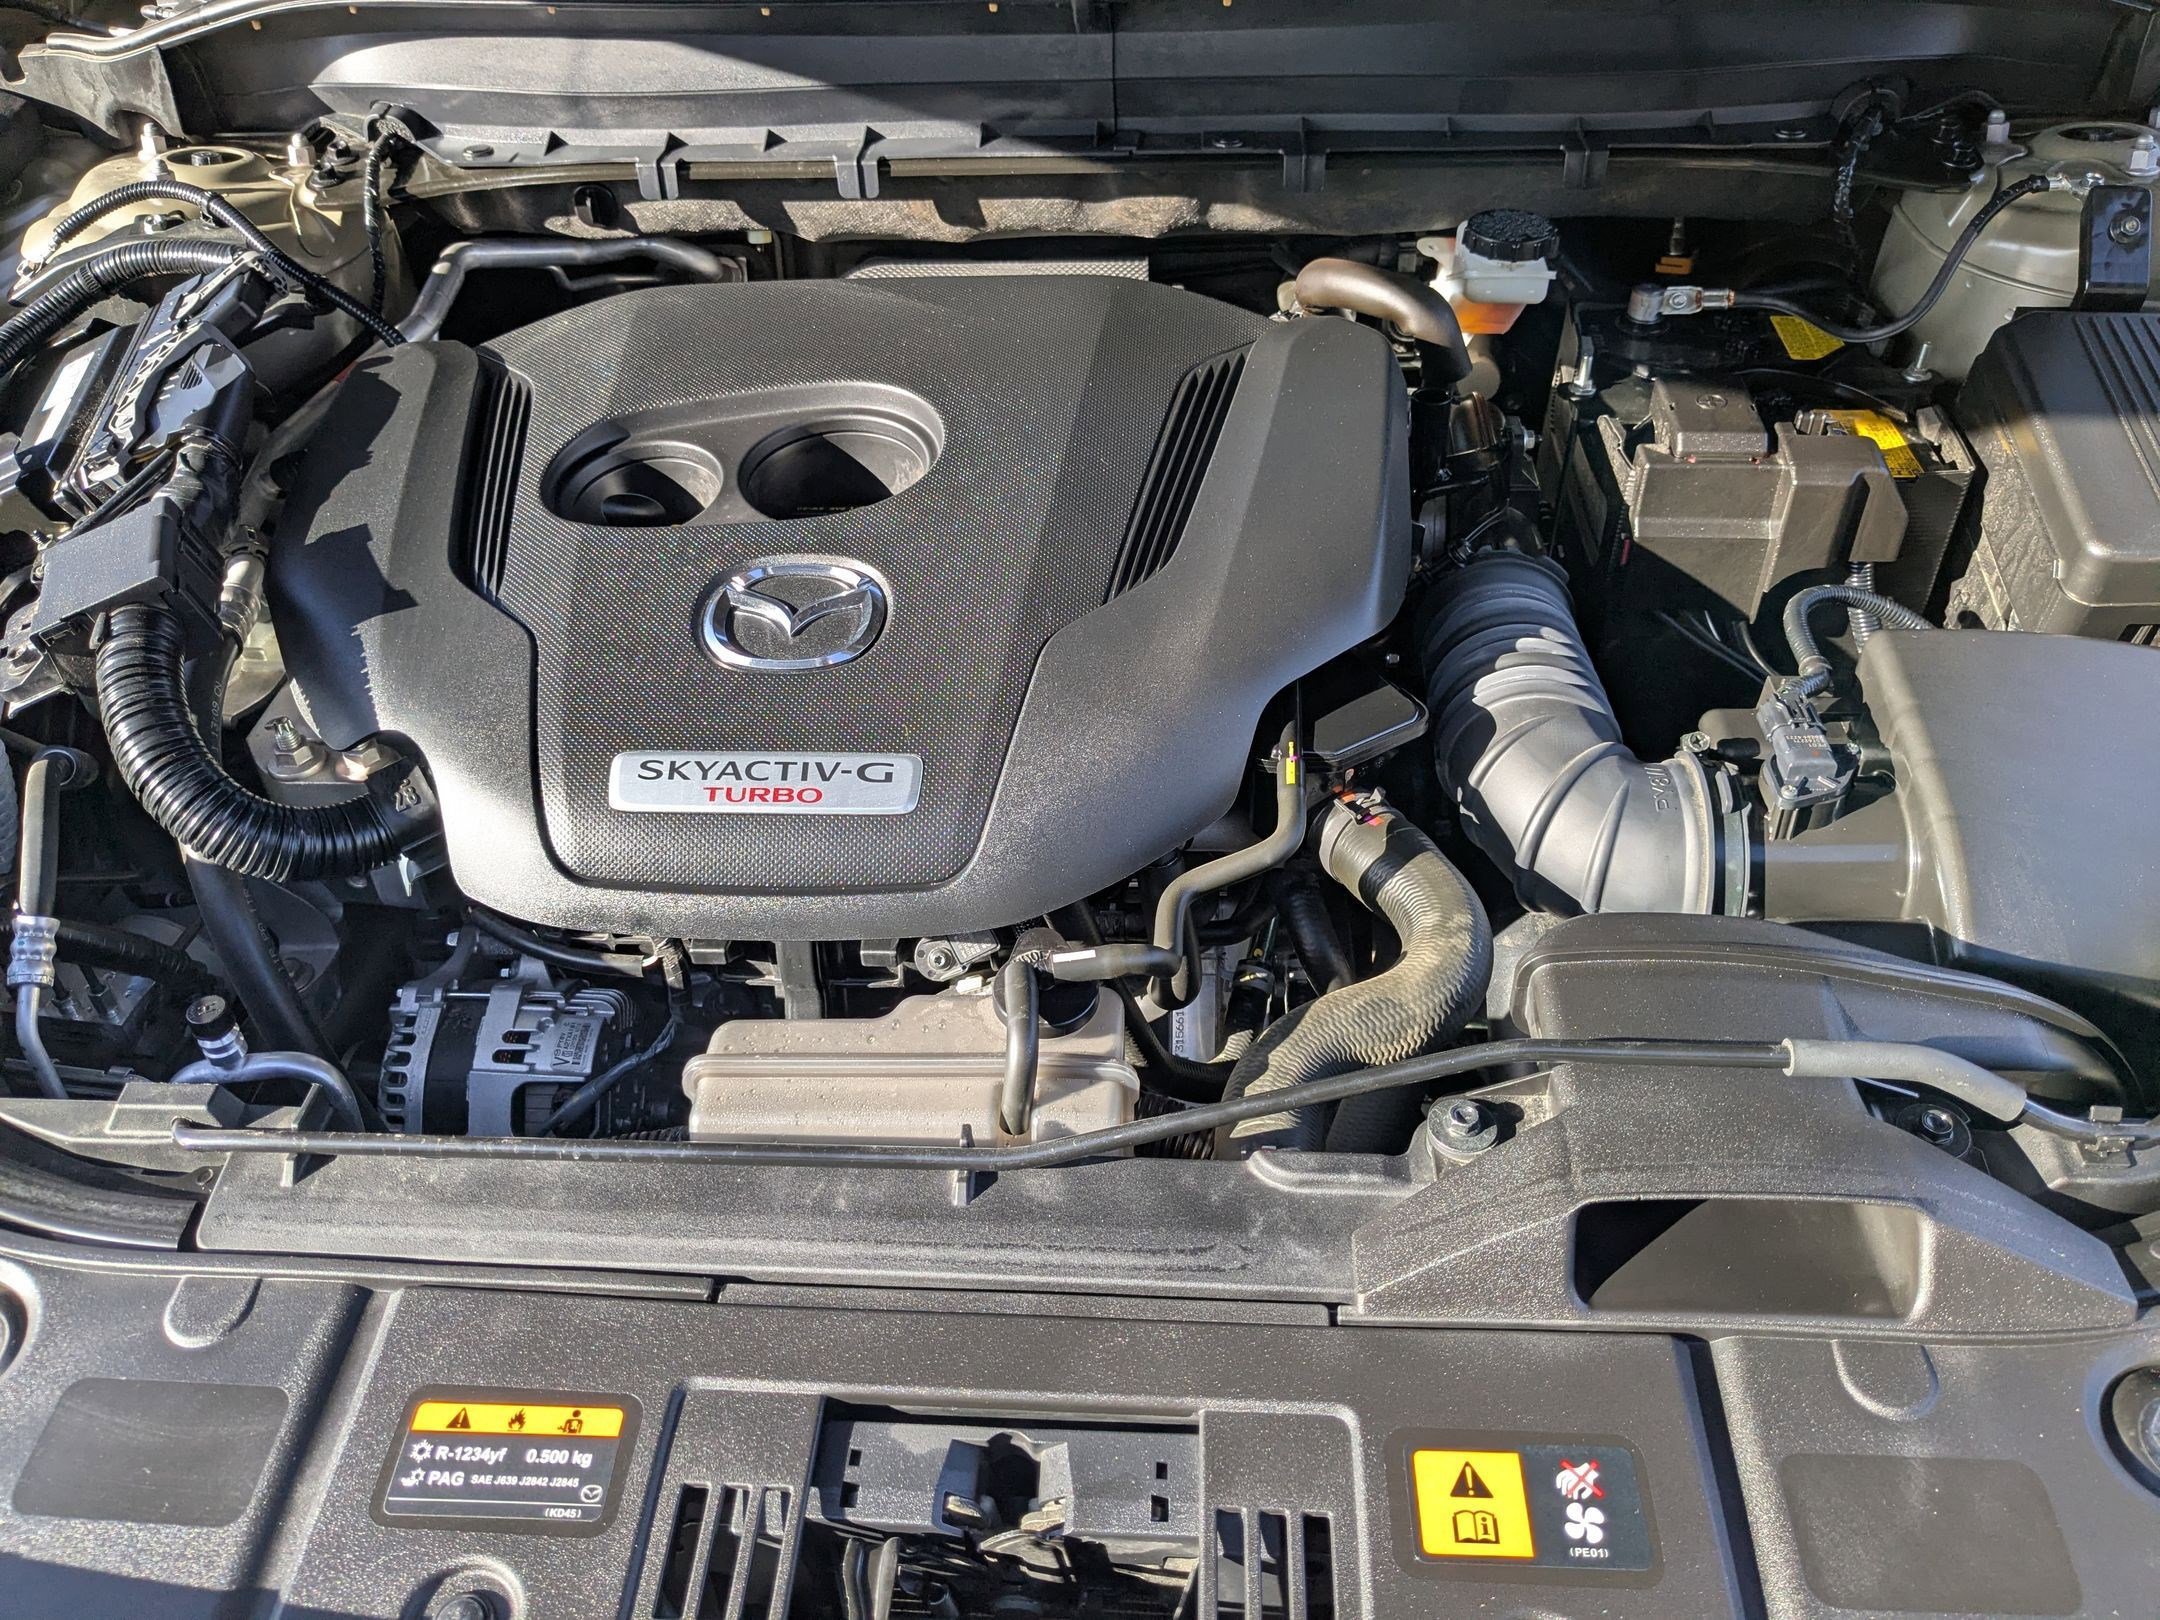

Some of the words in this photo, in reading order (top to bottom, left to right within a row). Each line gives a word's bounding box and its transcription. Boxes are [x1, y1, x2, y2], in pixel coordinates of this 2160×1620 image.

[637, 759, 895, 783] SKYACTIV-G
[703, 786, 823, 804] TURBO
[435, 1445, 508, 1465] R-1234yf
[526, 1448, 570, 1464] 0.500
[572, 1450, 593, 1469] kg
[428, 1470, 465, 1486] PAG
[470, 1475, 492, 1485] SAE
[494, 1475, 518, 1486] J639
[545, 1508, 582, 1519] (KD45)
[1569, 1547, 1609, 1559] (PE01)
